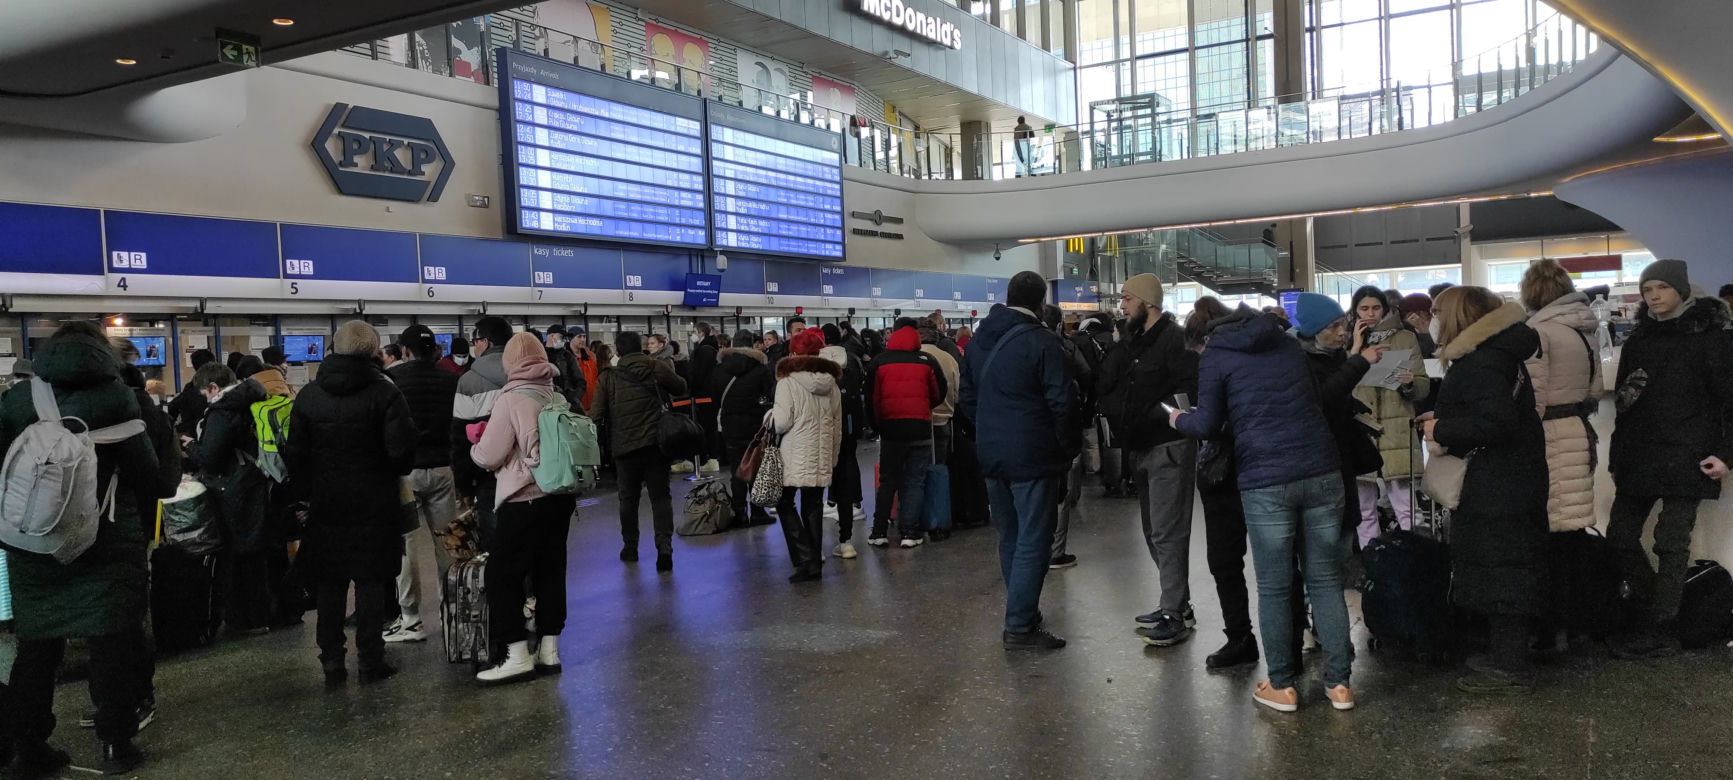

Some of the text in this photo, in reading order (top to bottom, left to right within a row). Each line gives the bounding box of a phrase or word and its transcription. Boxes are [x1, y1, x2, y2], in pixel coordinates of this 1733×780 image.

[862, 0, 962, 50] McDonald's
[337, 130, 438, 177] PKP
[534, 244, 574, 258] kasy tickets
[133, 253, 143, 265] R
[303, 261, 311, 272] R
[117, 276, 129, 292] 4
[290, 282, 299, 295] 5
[427, 286, 435, 298] 6
[537, 289, 544, 301] 7
[628, 291, 634, 302] 8
[767, 296, 775, 305] 10
